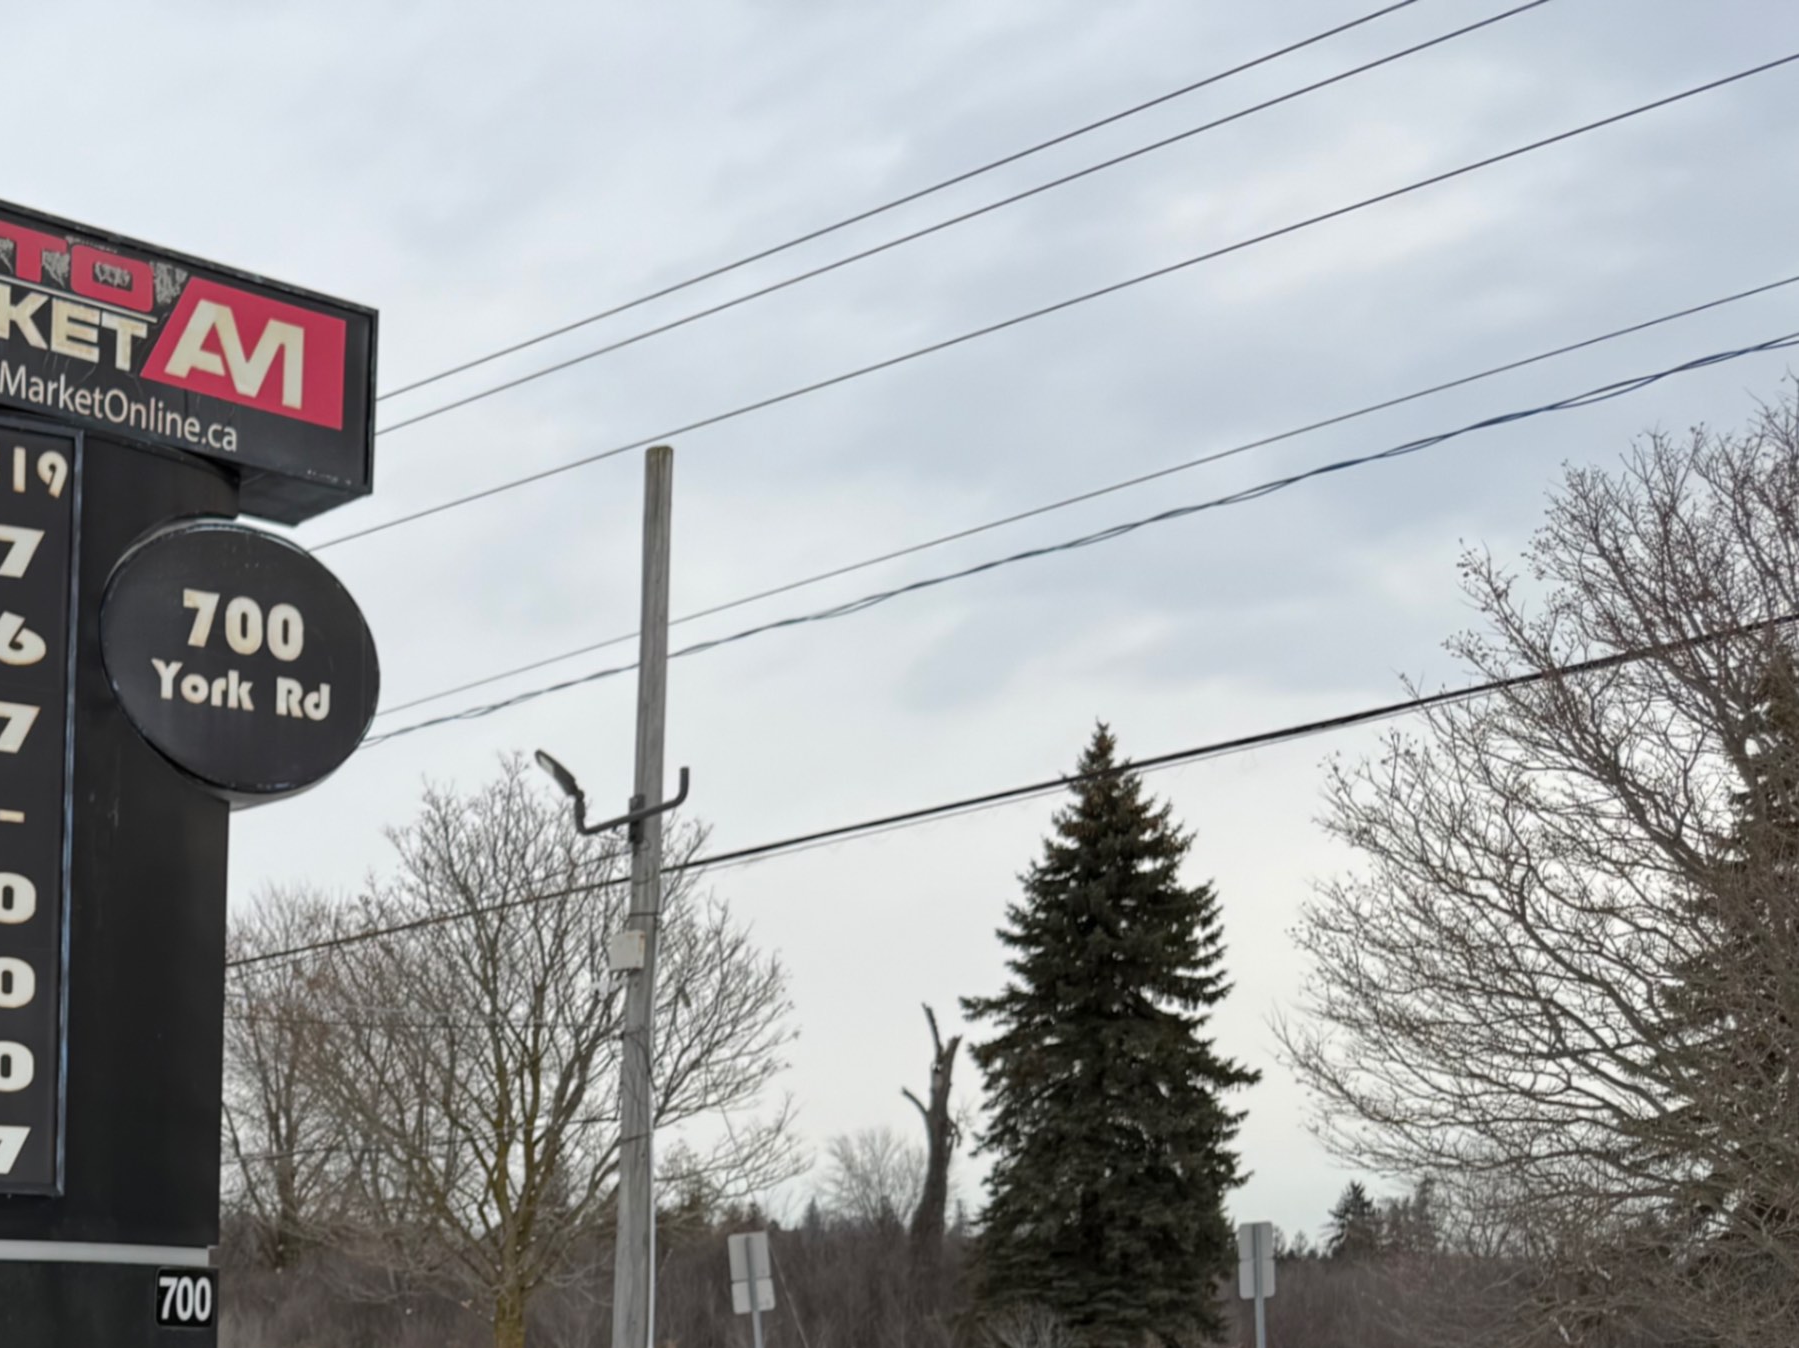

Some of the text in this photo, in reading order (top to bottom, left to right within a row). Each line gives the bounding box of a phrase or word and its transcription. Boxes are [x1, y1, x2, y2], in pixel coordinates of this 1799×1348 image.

[164, 299, 304, 410] AM
[182, 588, 304, 661] 700
[151, 658, 331, 721] York Rd
[159, 1276, 212, 1321] 700
